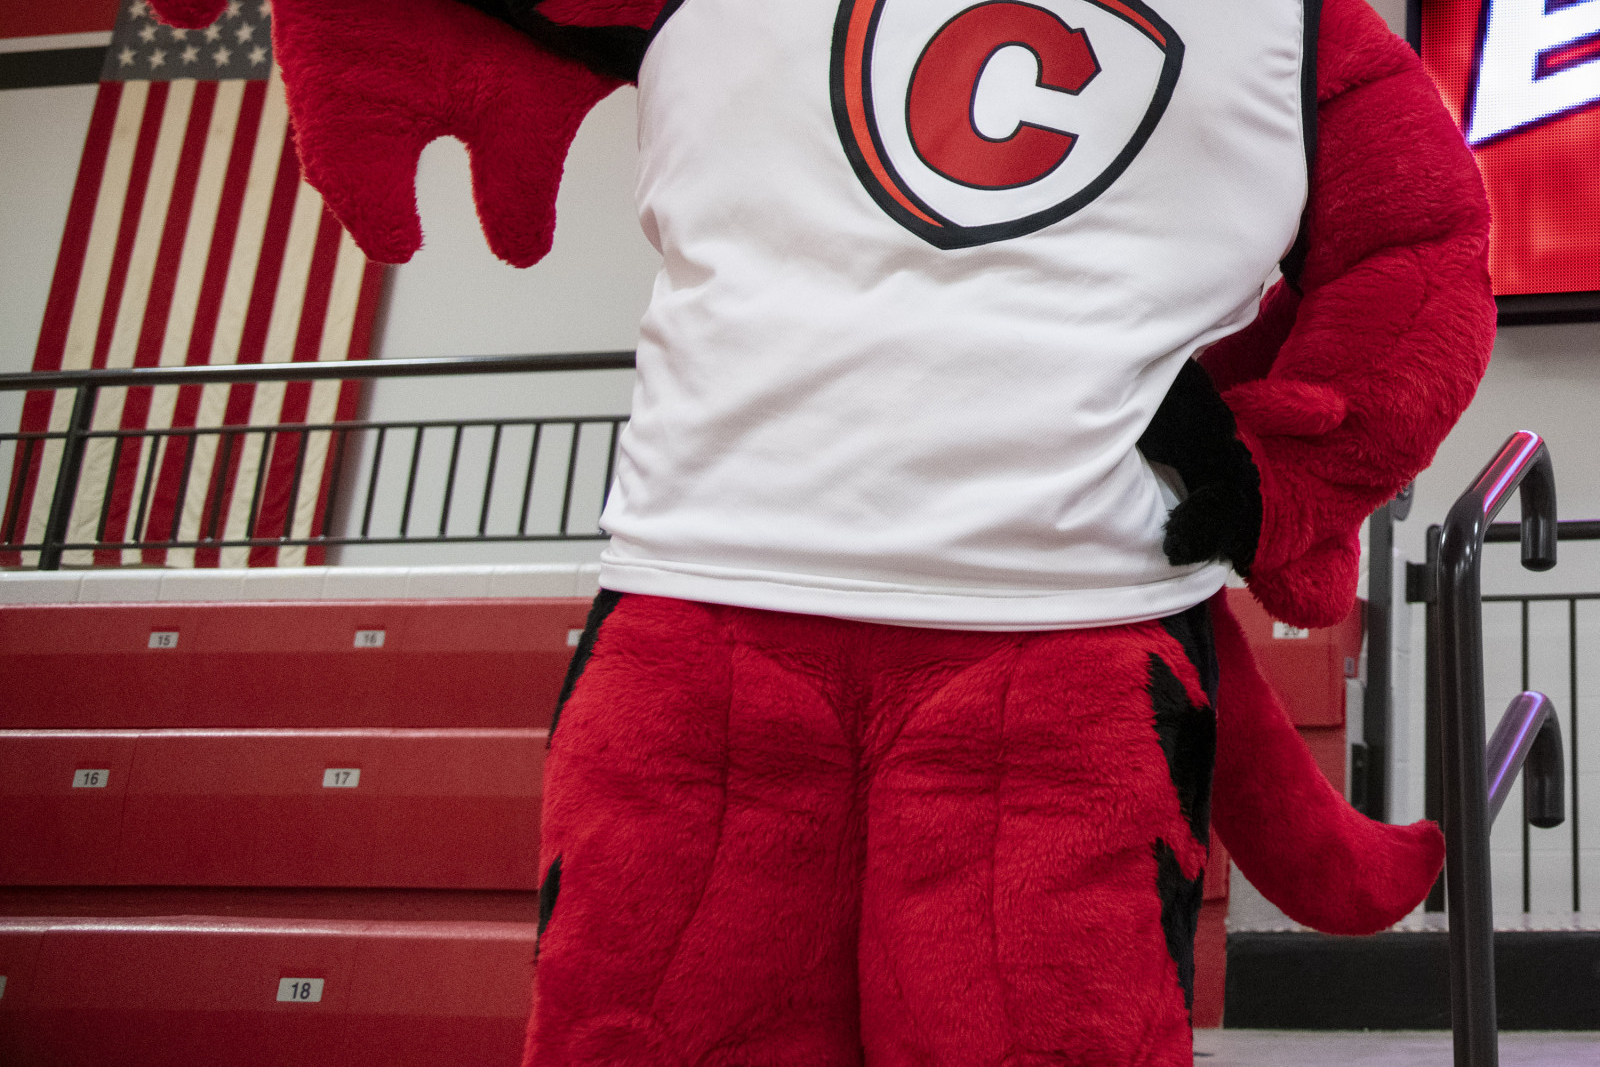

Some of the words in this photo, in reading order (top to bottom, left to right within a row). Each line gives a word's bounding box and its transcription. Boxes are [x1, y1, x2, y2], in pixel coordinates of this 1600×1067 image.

[905, 0, 1102, 191] C
[84, 772, 99, 785] 16
[335, 771, 351, 785] 17
[291, 981, 312, 1000] 18
